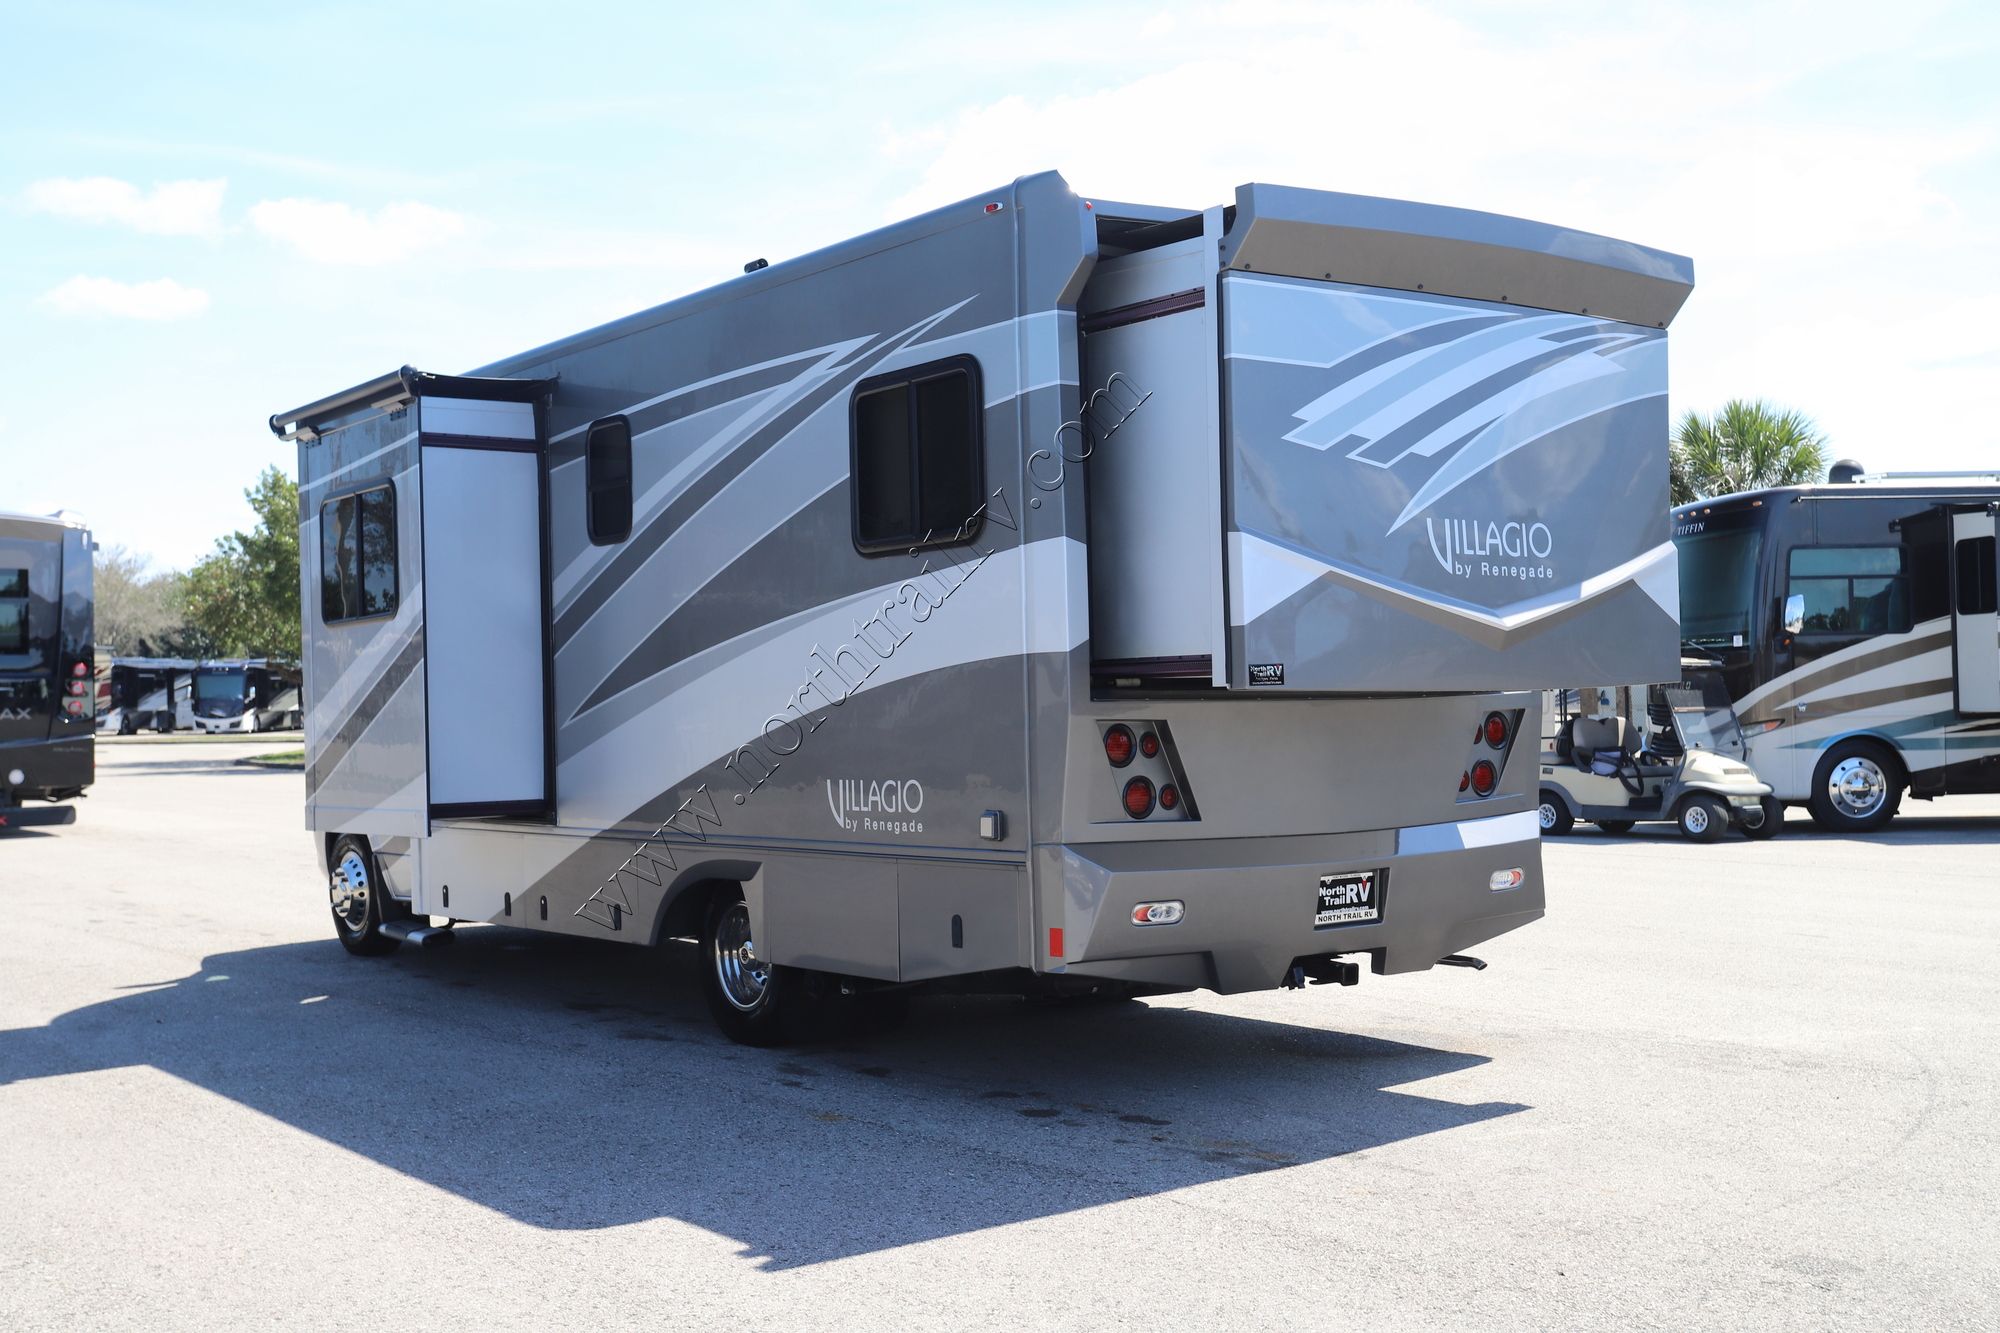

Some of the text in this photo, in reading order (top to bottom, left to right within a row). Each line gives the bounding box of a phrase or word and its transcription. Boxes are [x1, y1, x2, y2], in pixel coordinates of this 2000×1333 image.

[1677, 522, 1705, 536] TIFFIN
[1426, 517, 1552, 575] VILLAGIO
[1455, 561, 1553, 580] by Renegade
[1266, 665, 1282, 677] RV
[826, 779, 923, 828] VILLAGIO
[845, 817, 923, 834] by Renegade
[1319, 885, 1346, 897] North
[1346, 882, 1371, 904] RV
[1323, 895, 1346, 906] Trail
[1318, 914, 1341, 922] NORTH
